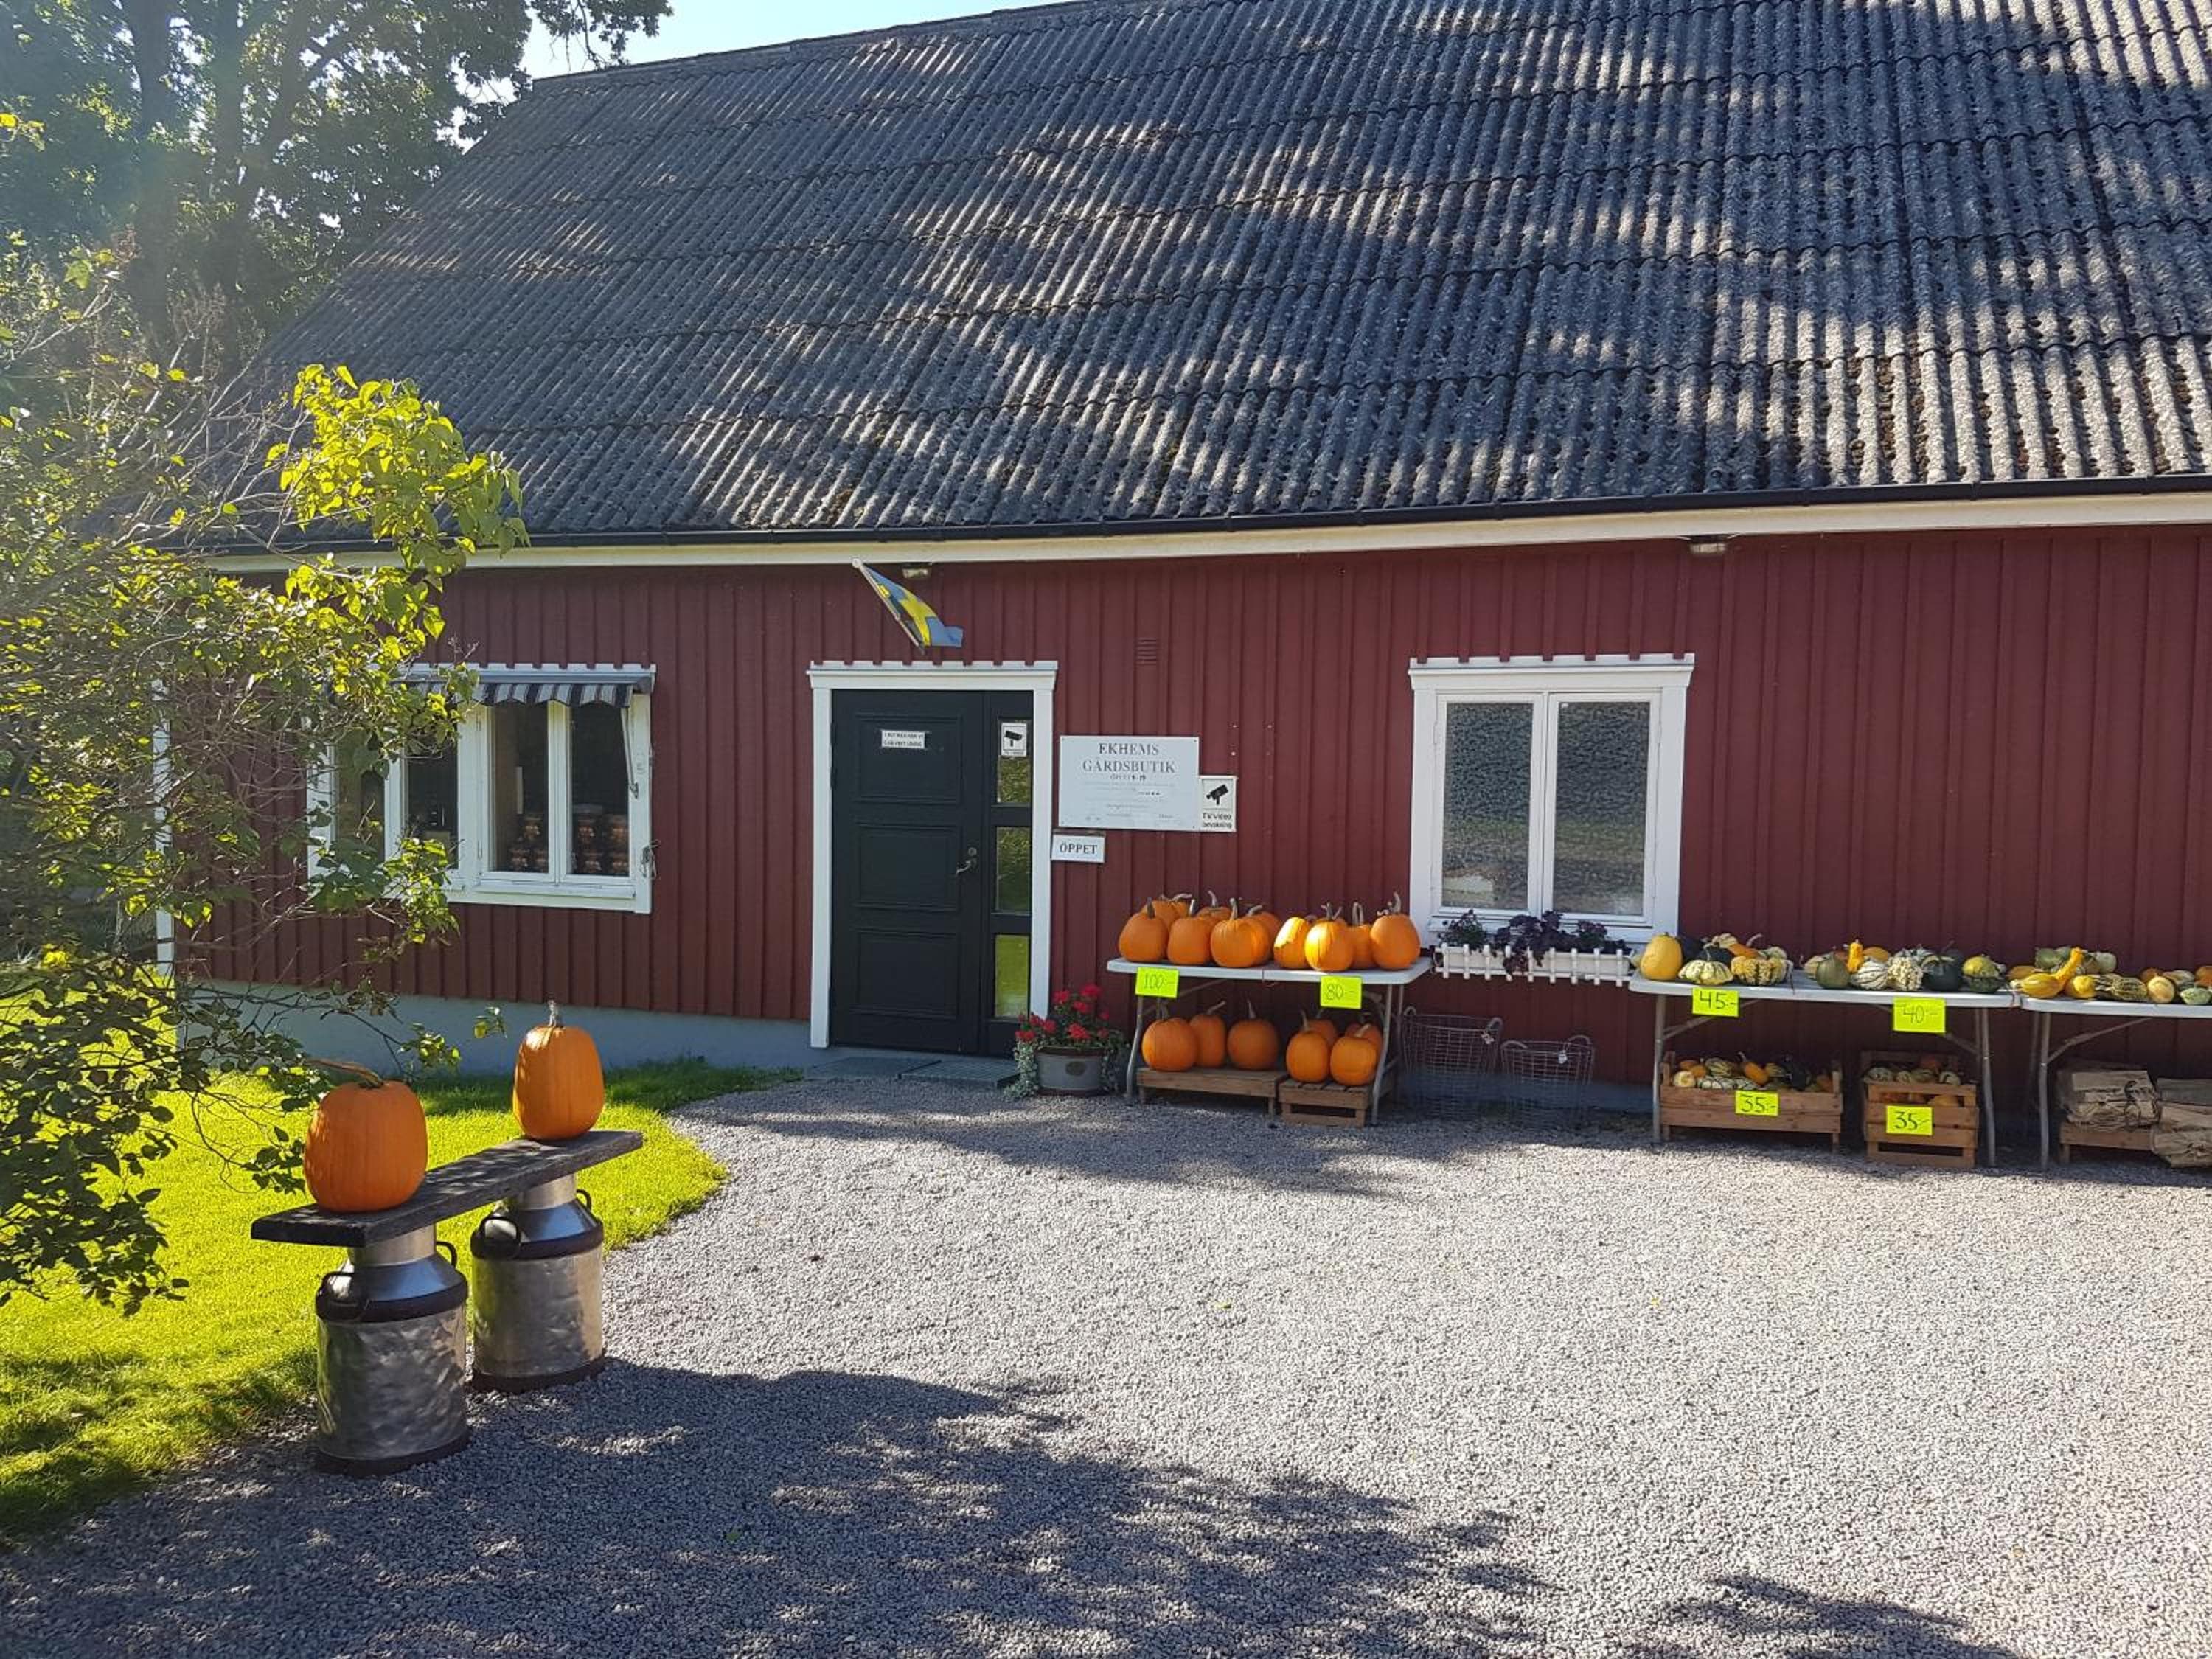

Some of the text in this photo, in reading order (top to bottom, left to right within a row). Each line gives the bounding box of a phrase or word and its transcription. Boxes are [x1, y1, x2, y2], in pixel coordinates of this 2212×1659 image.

[1099, 742, 1159, 756] EKHEMS
[1082, 757, 1176, 773] GÅRDSBUTIK
[1060, 841, 1098, 855] ÖPPET
